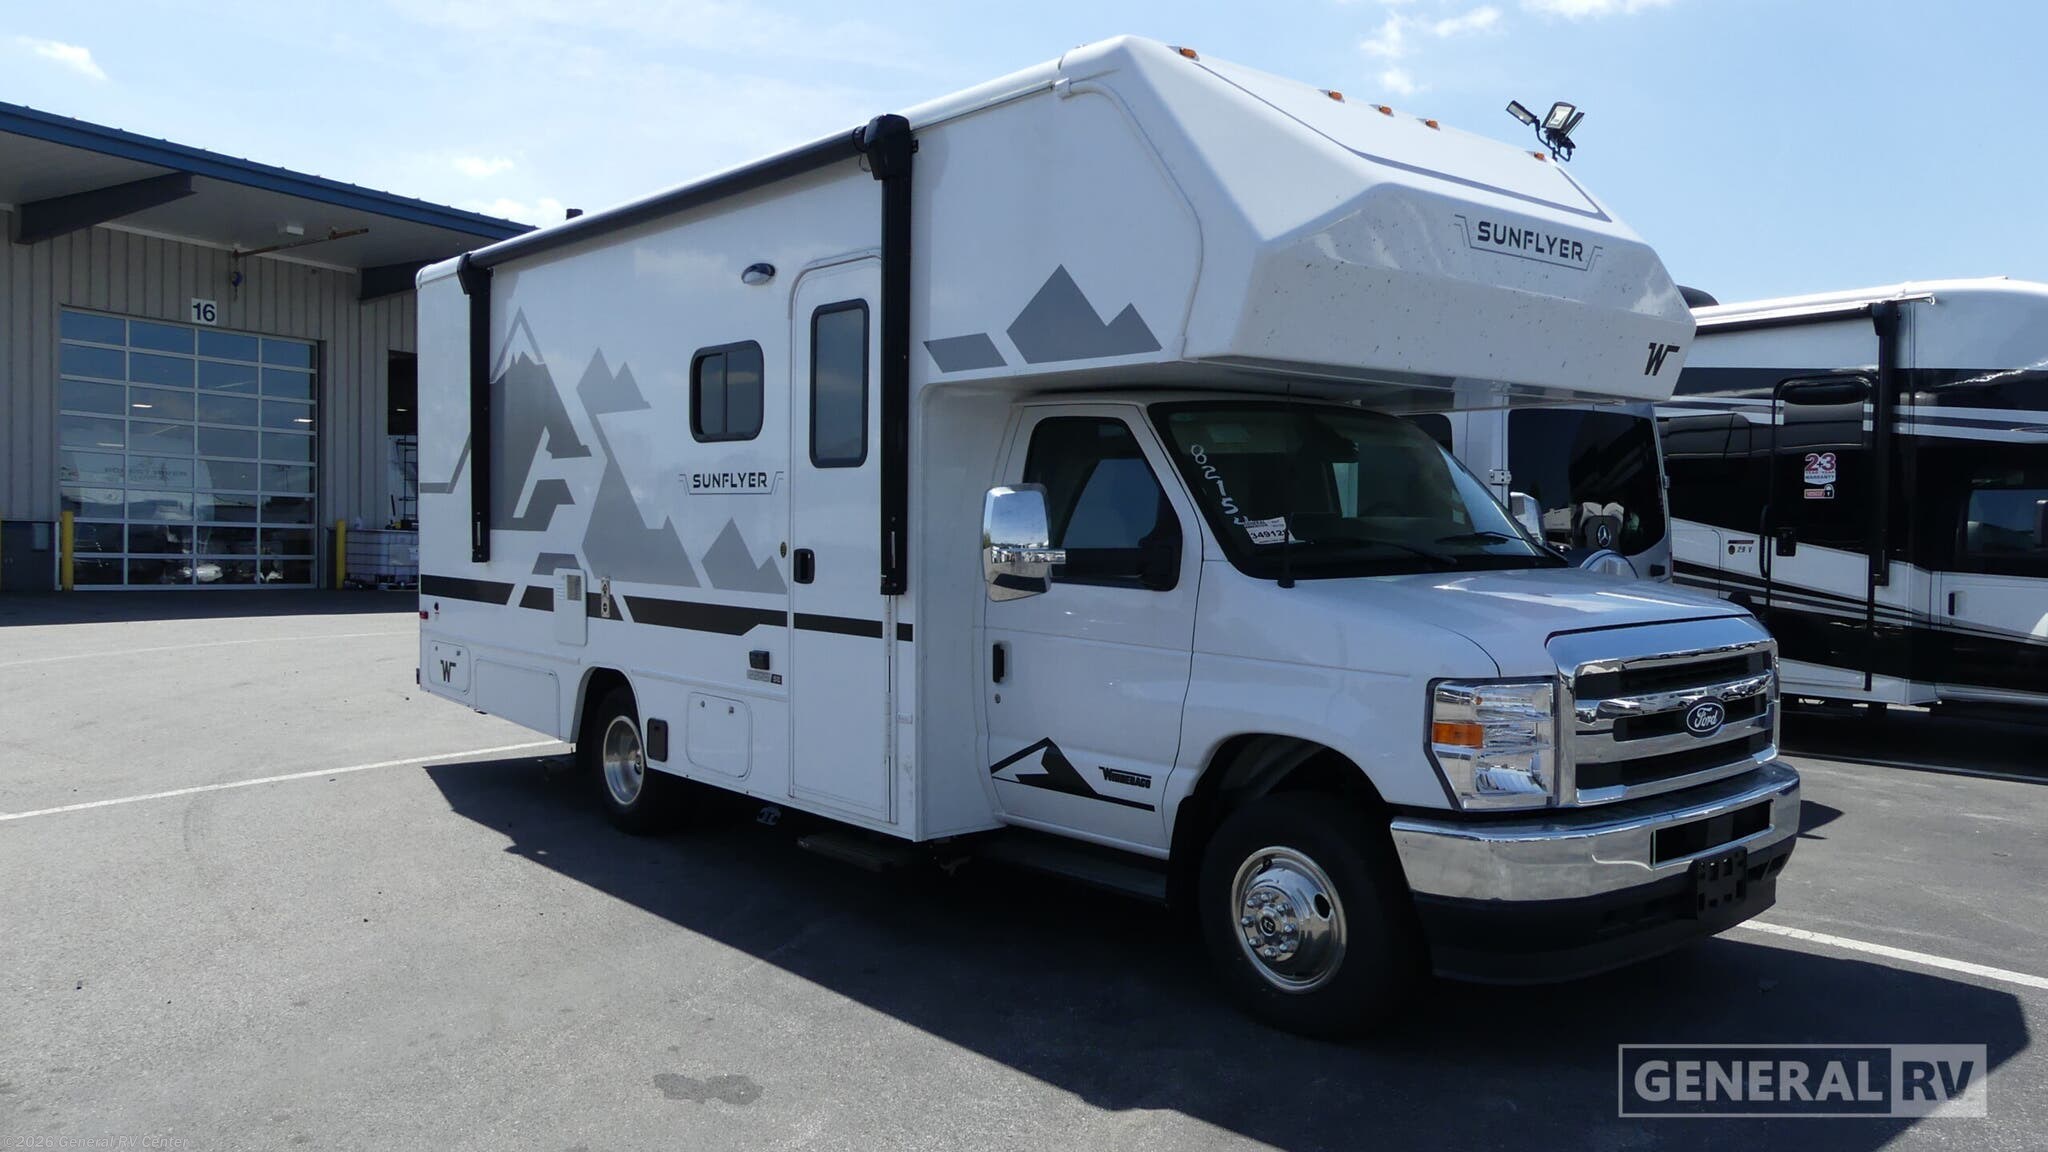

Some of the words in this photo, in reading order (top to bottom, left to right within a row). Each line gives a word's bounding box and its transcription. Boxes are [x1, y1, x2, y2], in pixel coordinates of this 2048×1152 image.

[1477, 220, 1584, 262] SUNFLYER
[193, 302, 215, 322] 16
[692, 472, 768, 489] SUNFLYER
[1694, 706, 1719, 728] Ford
